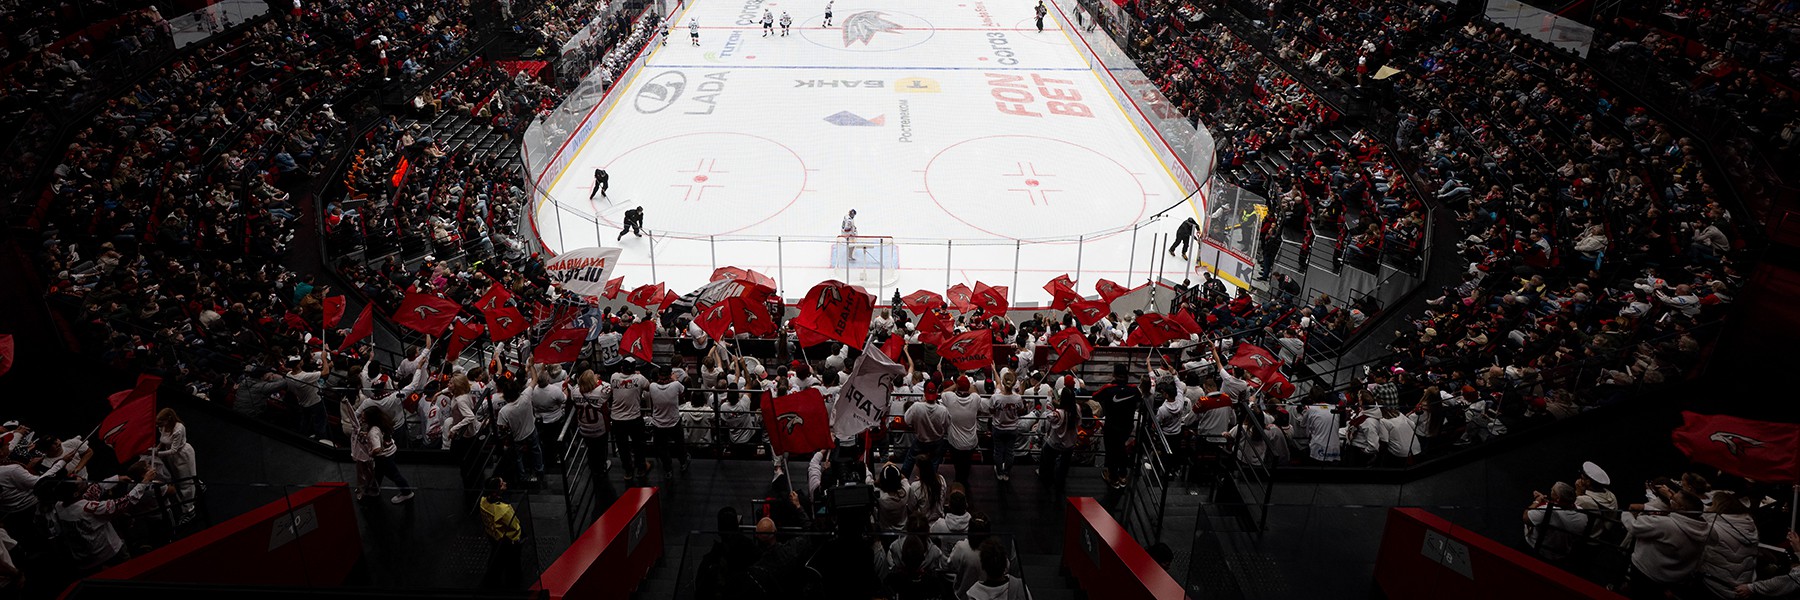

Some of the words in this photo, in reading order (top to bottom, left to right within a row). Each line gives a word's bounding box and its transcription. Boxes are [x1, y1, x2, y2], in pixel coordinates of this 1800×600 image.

[684, 70, 731, 116] LADA
[794, 79, 885, 88] БАНК
[984, 72, 1043, 118] FON
[1030, 72, 1096, 118] BET
[602, 343, 619, 360] 35
